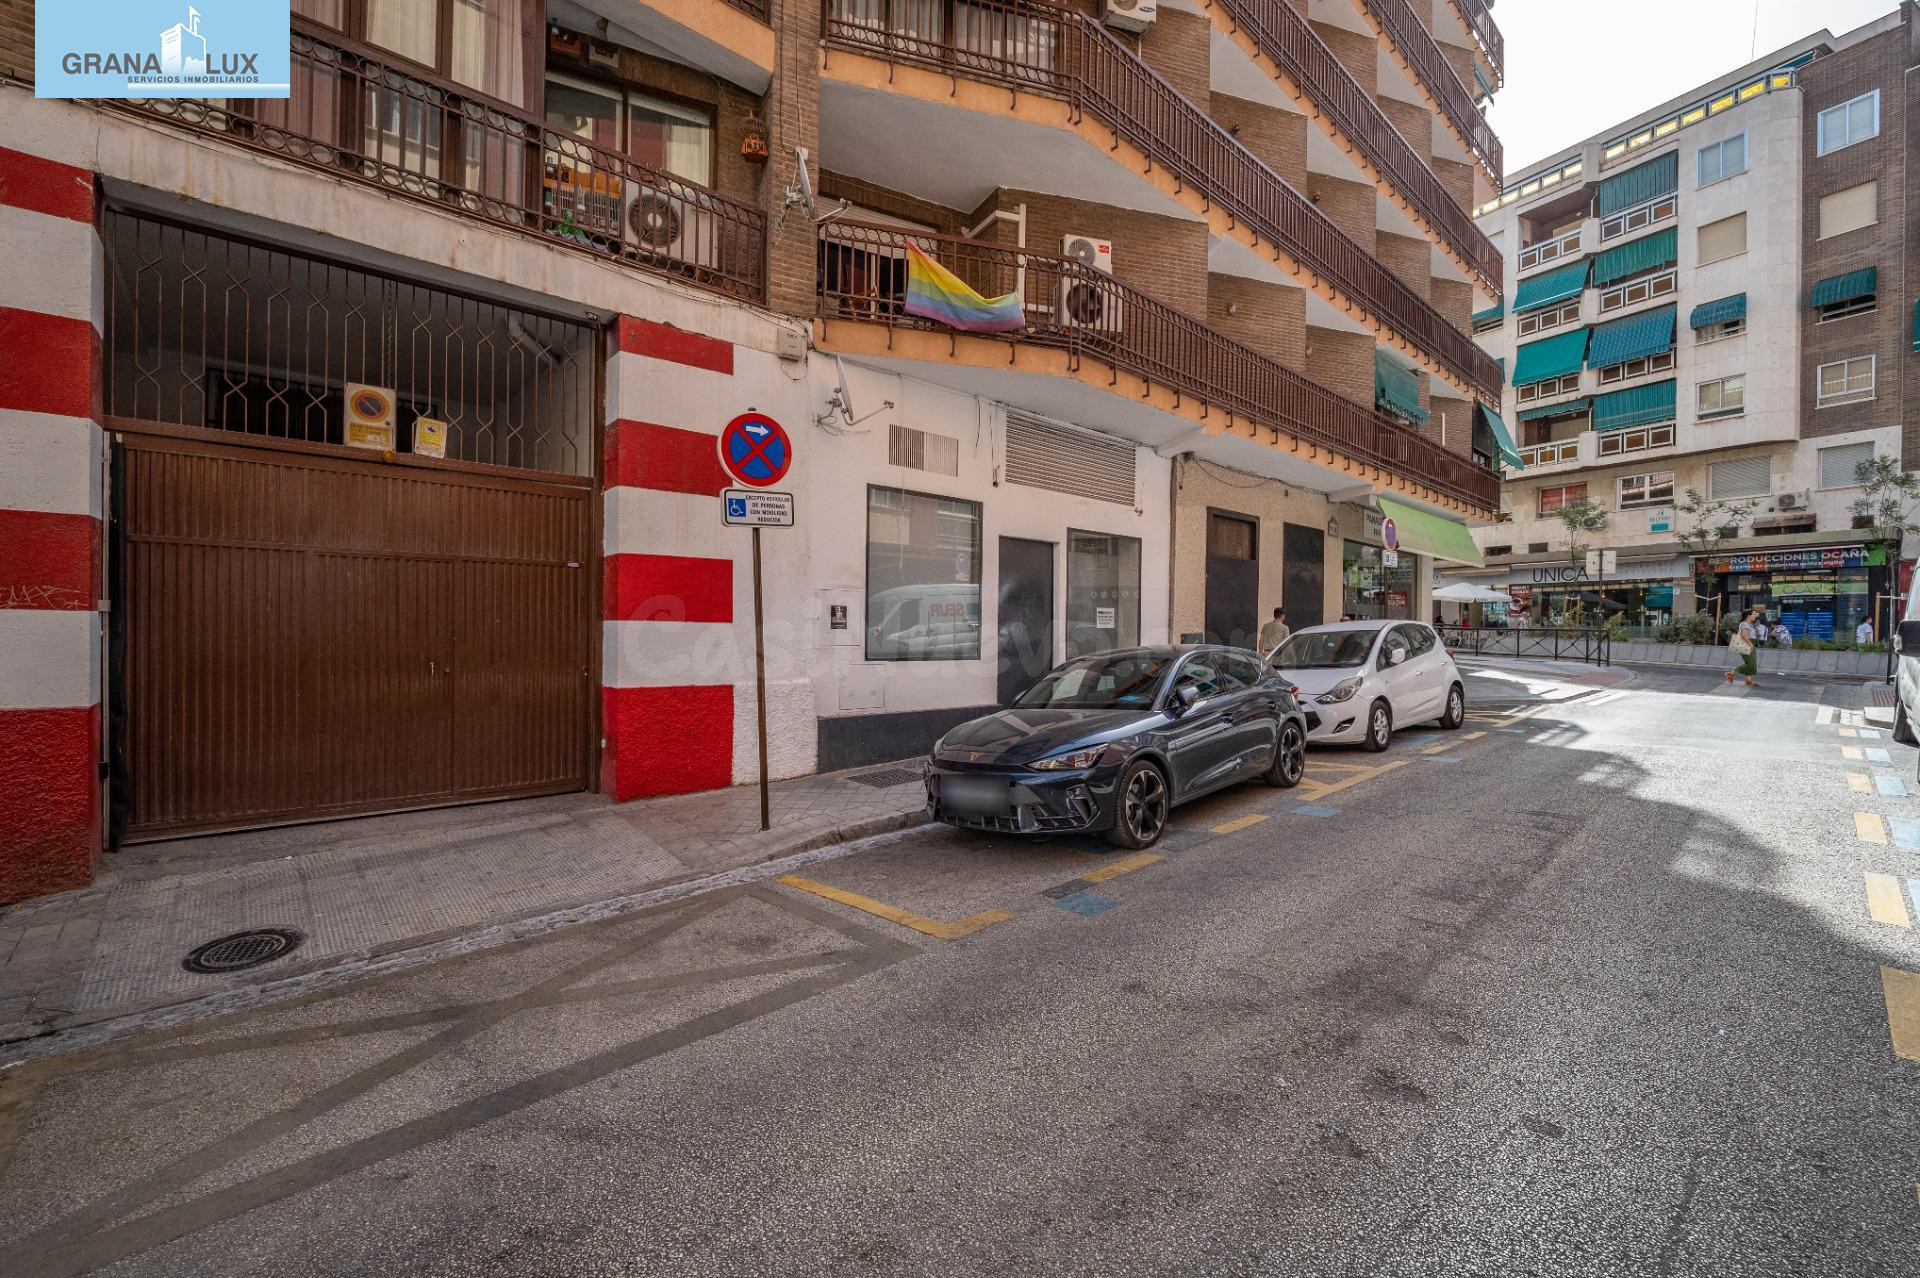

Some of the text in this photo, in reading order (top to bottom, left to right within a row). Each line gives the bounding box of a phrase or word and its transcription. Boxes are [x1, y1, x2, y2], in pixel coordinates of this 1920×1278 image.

[1708, 547, 1870, 566] REPRODUCCIONES OCAÑA
[1532, 566, 1590, 583] UNICA
